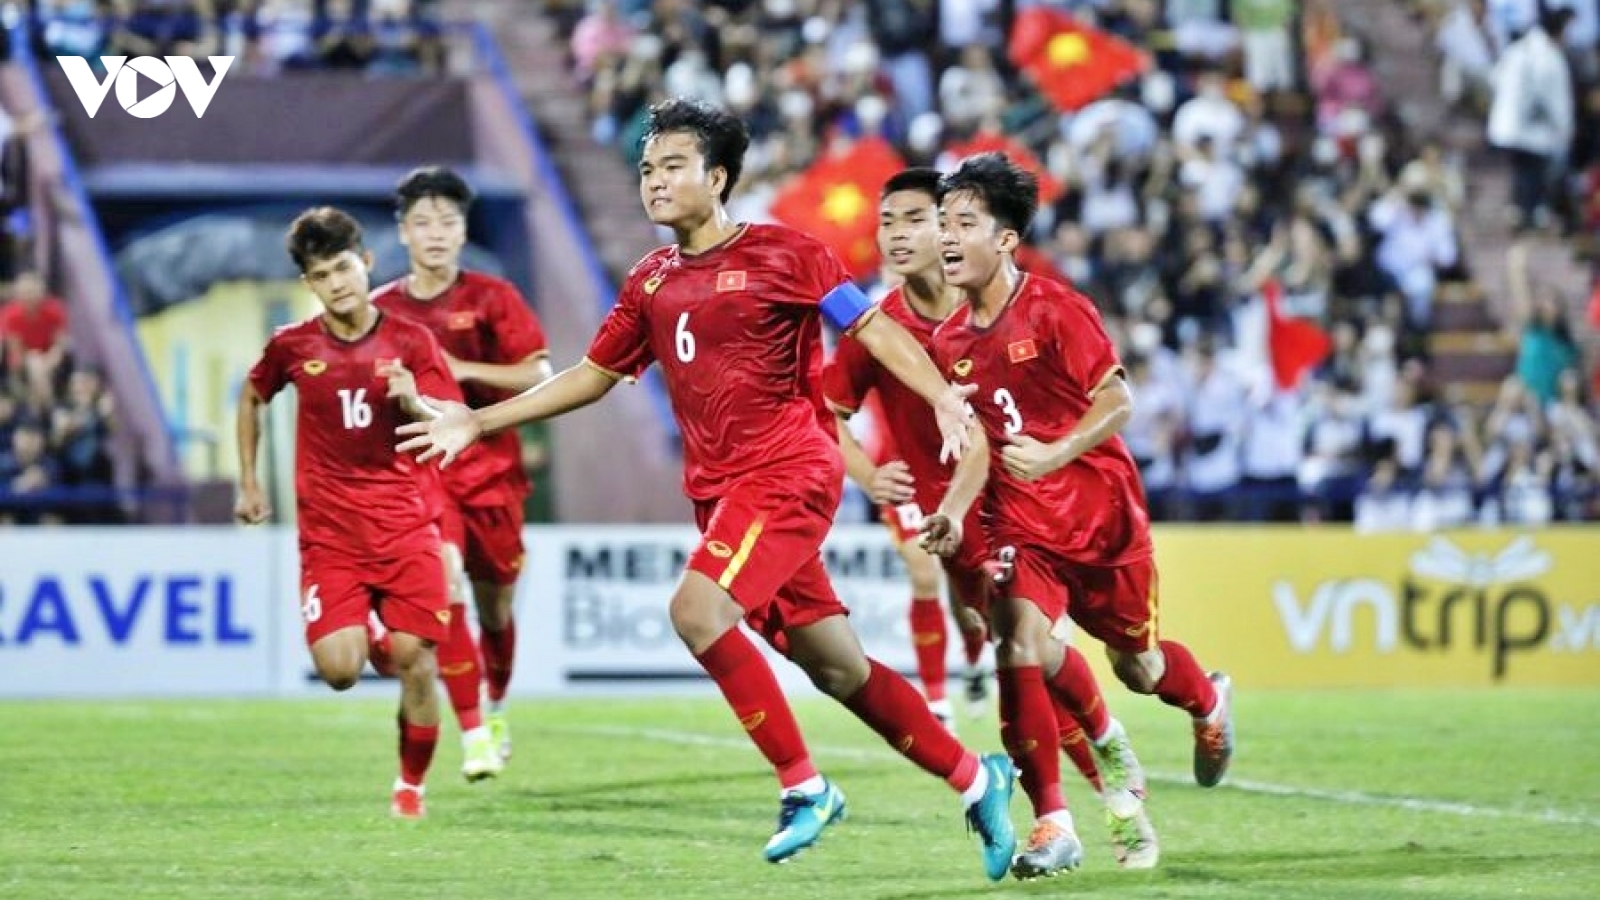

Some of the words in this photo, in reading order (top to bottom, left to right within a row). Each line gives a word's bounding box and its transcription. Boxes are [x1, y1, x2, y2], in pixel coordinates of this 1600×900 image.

[675, 311, 696, 363] 6
[336, 387, 373, 429] 16
[993, 387, 1023, 435] 3
[0, 574, 253, 645] AVEL
